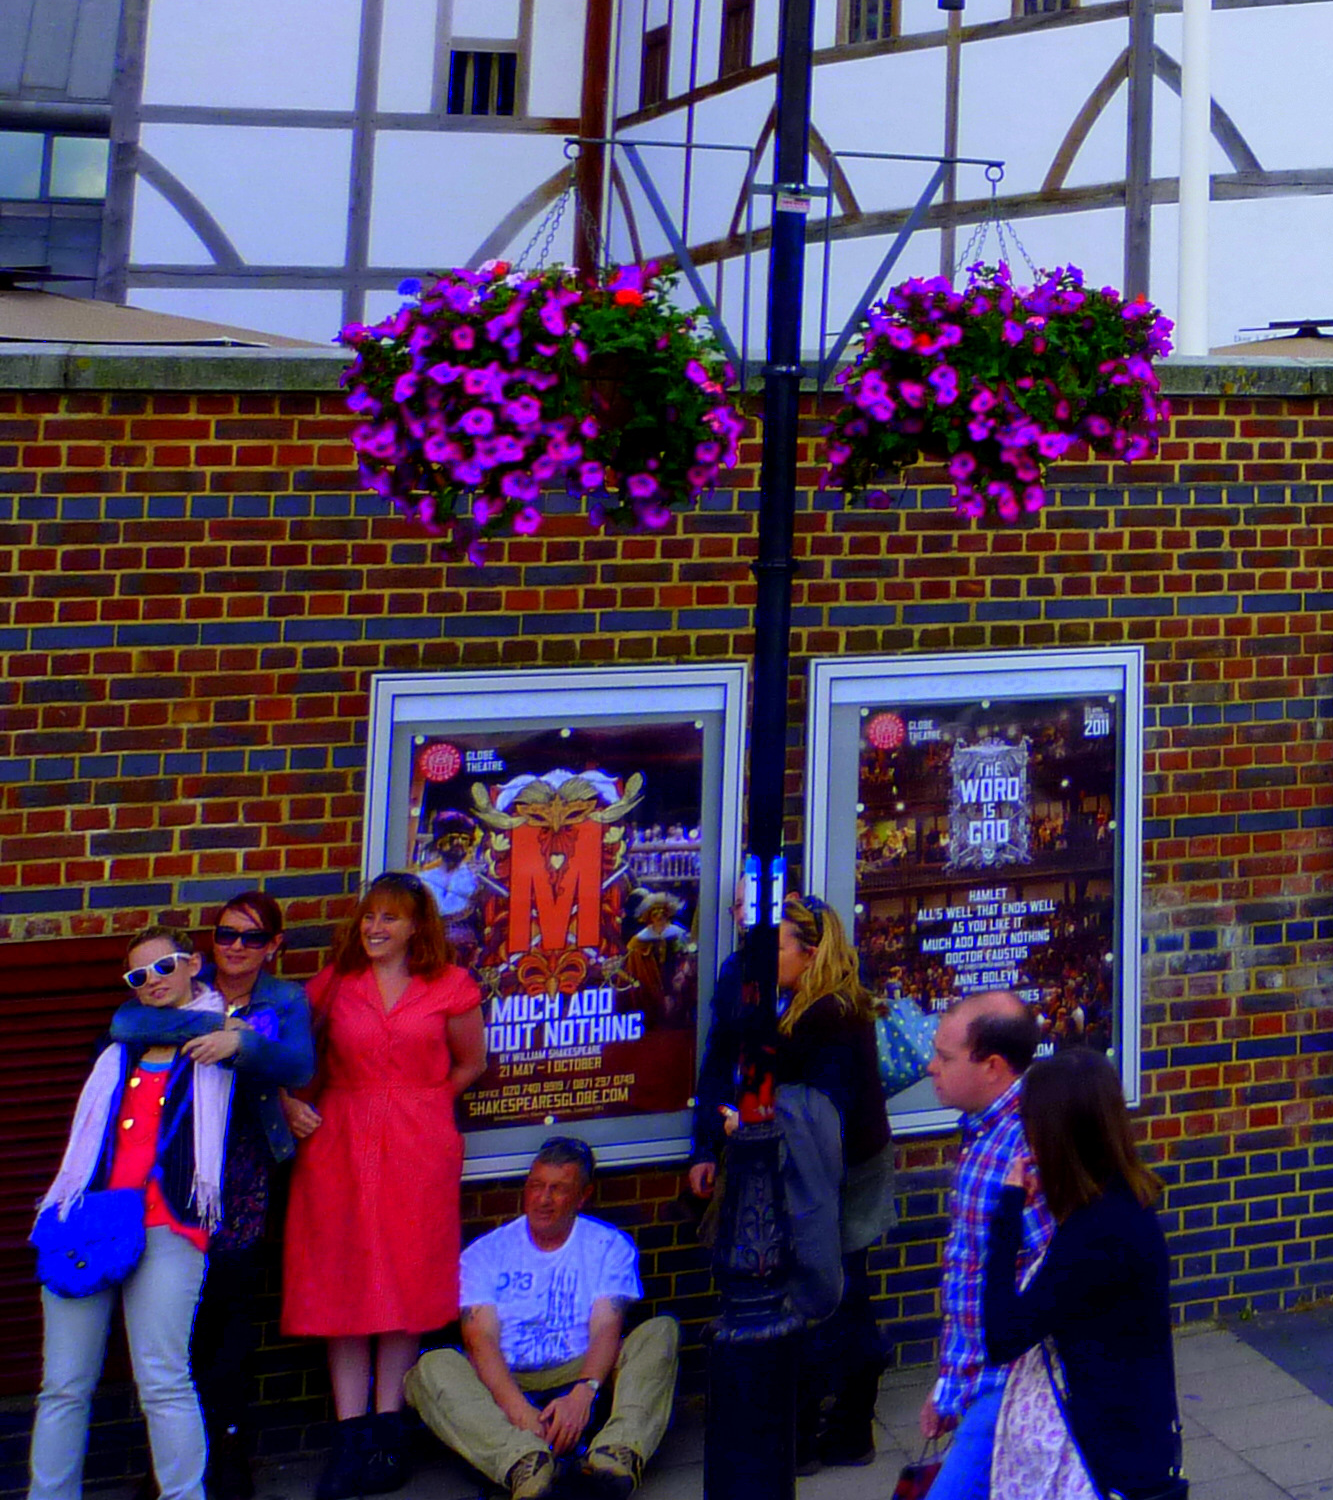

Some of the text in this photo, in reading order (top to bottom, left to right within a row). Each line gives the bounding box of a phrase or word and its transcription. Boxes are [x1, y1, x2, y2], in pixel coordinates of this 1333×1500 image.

[1084, 719, 1109, 736] 2011
[466, 750, 495, 761] GLOBE
[466, 760, 504, 772] THEATRE
[979, 762, 1001, 776] THE
[960, 777, 1019, 803] WORD
[983, 802, 995, 819] IS
[969, 819, 1009, 844] GOD
[969, 888, 1007, 902] HAMLET
[917, 899, 1055, 920] ALL'S WELL THAT ENDS WELL
[952, 917, 1023, 934] AS YOU LIKE IT
[922, 929, 1050, 951] MUCH ADO ABOUT NOTHING
[945, 946, 1028, 965] DOCTOR FAUSTUS
[954, 970, 1018, 986] ANNE BOLEYN
[491, 987, 613, 1023] MUCH ADO
[931, 998, 948, 1011] THE
[484, 1013, 642, 1052] OUT NOTHING
[500, 1045, 602, 1063] BY WILLIAM SHAKESPEARE
[499, 1066, 510, 1077] 21
[513, 1063, 536, 1076] MAY
[554, 1056, 602, 1072] OCTOBER
[502, 1085, 520, 1096] 020
[469, 1088, 628, 1117] SHAKESPEARESGLOBE.COM
